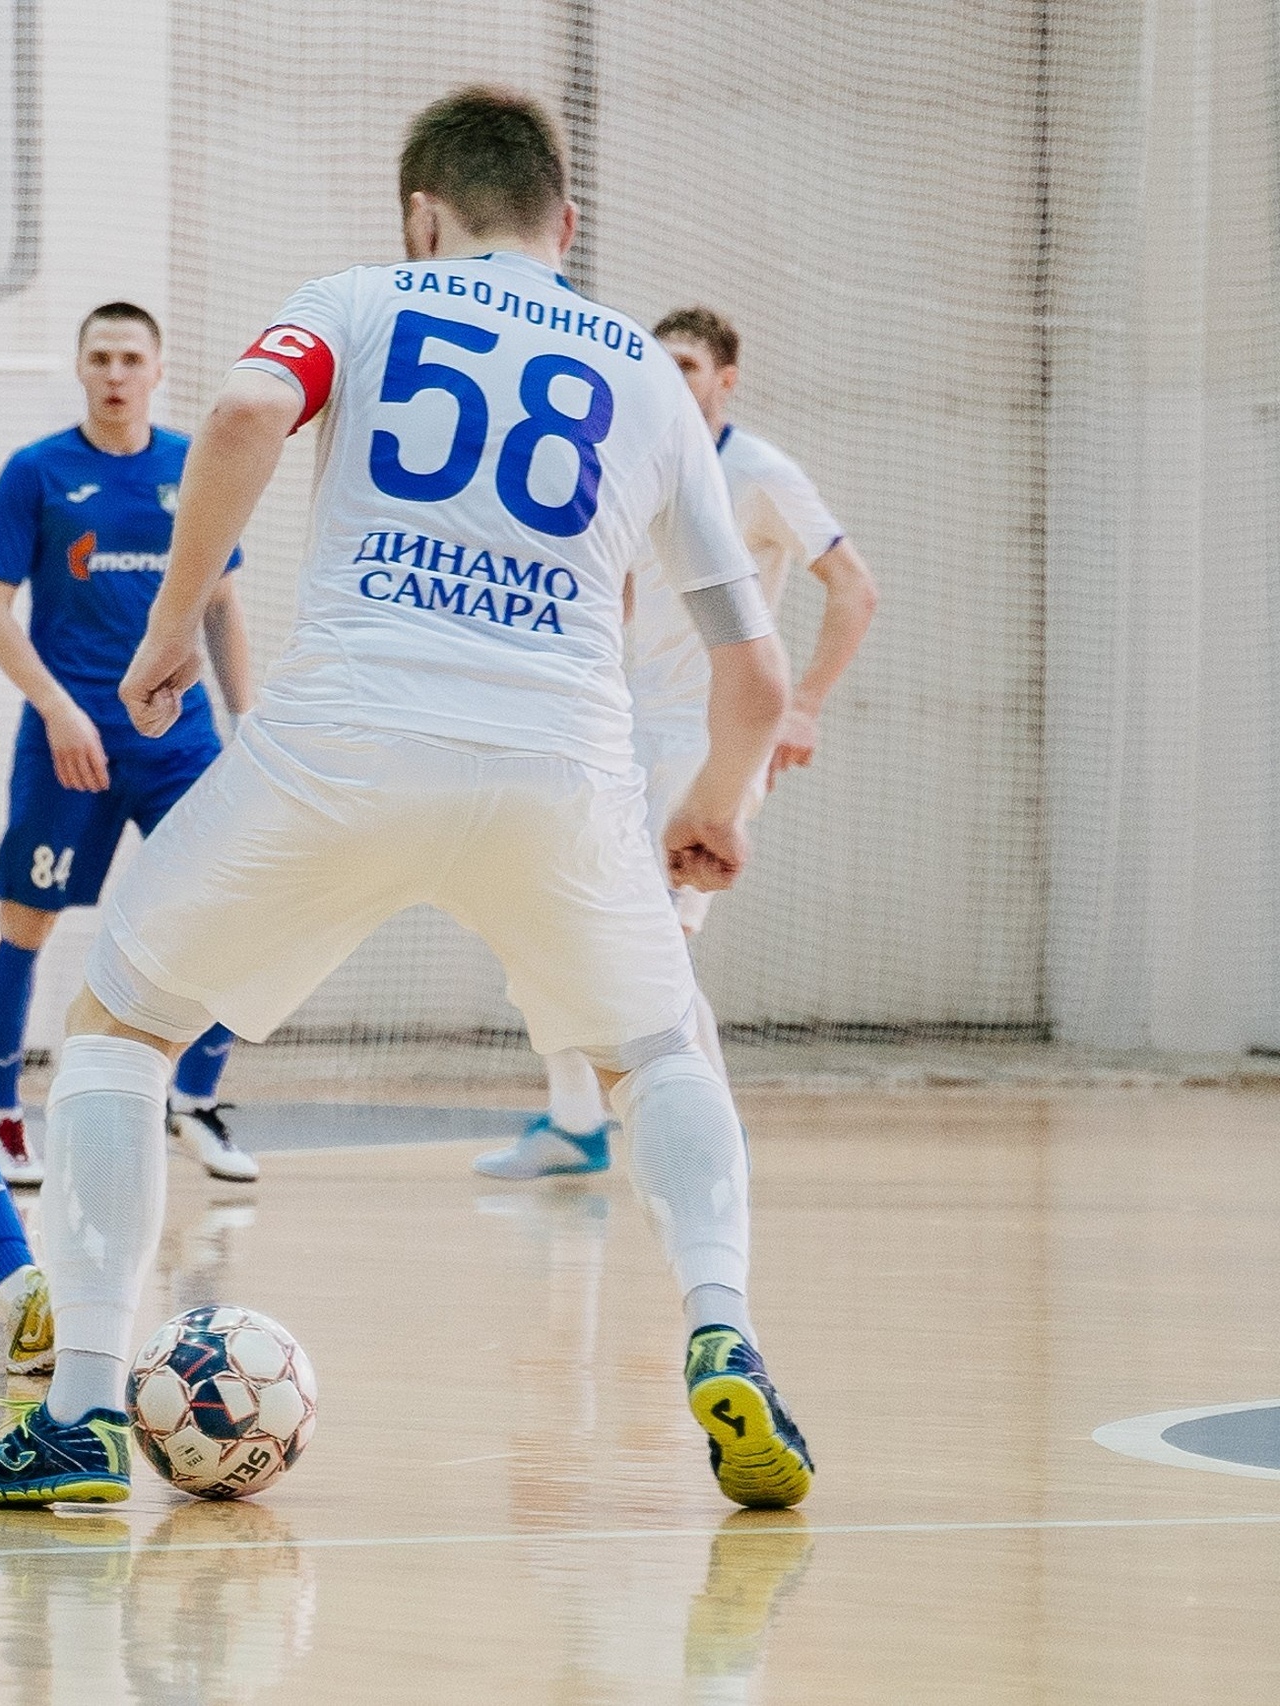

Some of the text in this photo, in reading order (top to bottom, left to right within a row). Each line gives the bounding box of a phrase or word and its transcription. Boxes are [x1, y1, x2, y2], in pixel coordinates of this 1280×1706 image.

[260, 328, 316, 358] C
[394, 269, 645, 362] ЗАБОЛОНКОВ
[369, 308, 614, 538] 58
[87, 552, 171, 573] mon
[354, 531, 579, 602] ДИНАМО
[359, 571, 565, 635] САМАРА
[30, 845, 75, 891] 84
